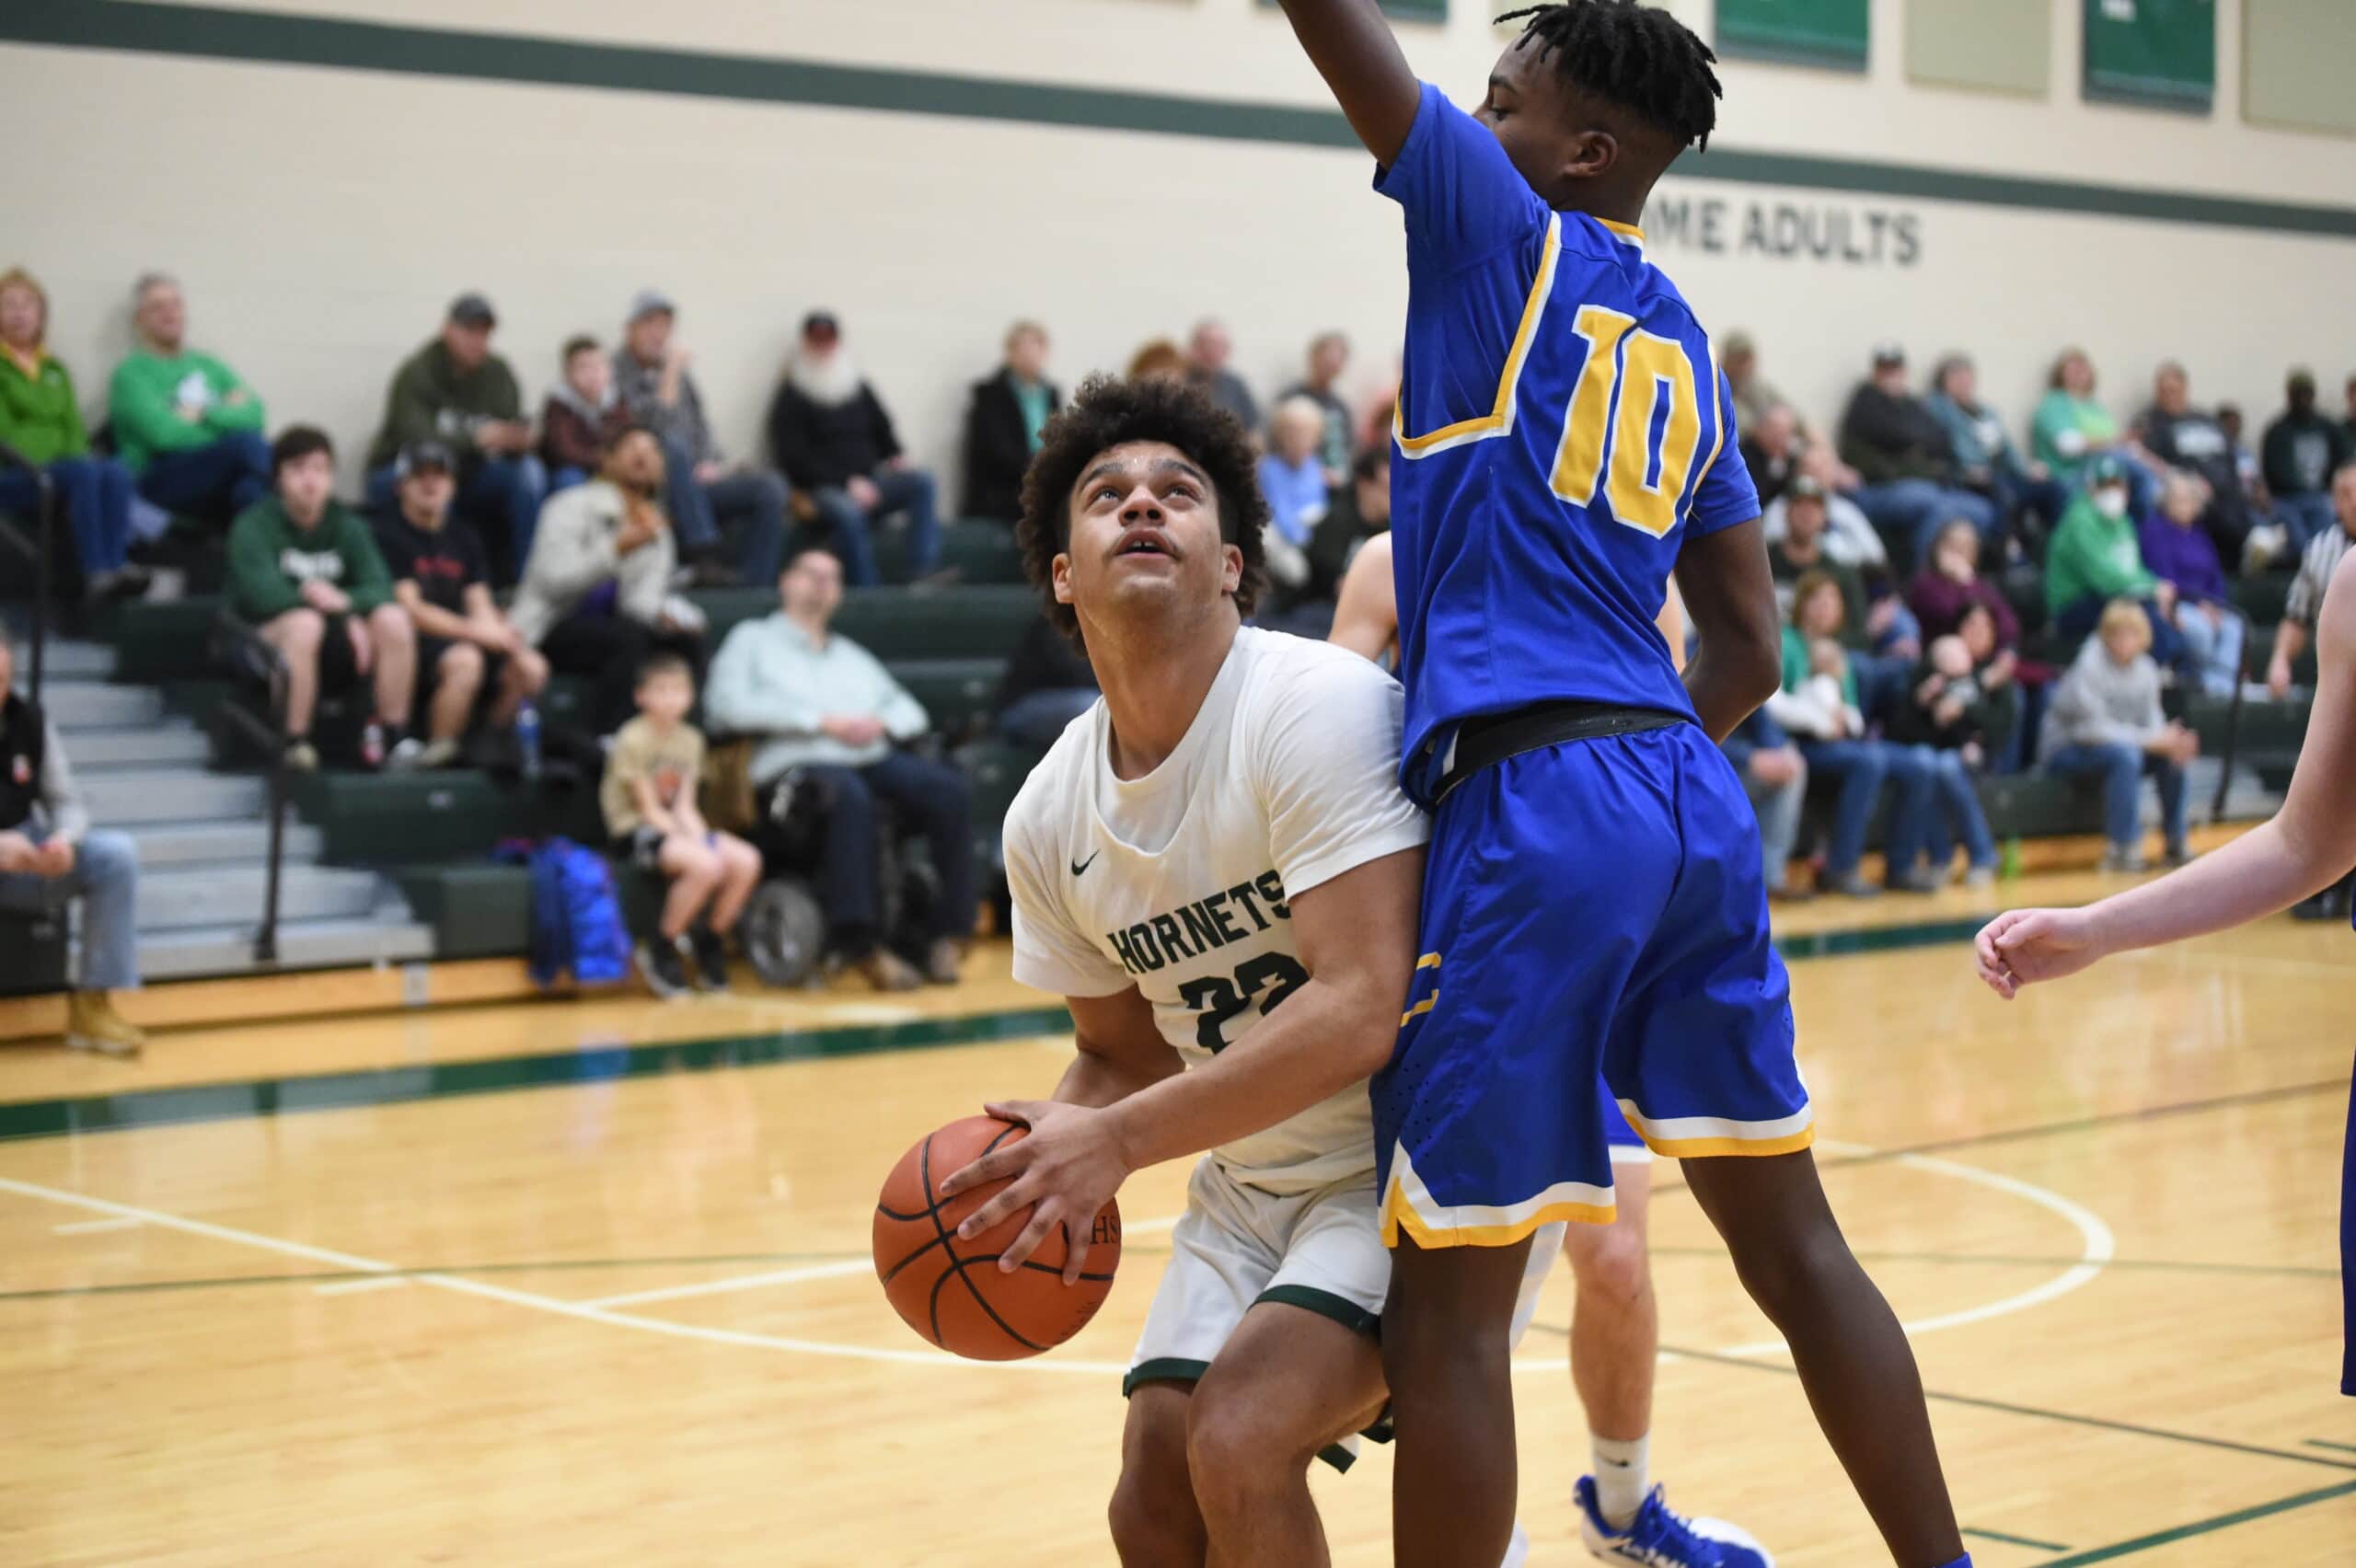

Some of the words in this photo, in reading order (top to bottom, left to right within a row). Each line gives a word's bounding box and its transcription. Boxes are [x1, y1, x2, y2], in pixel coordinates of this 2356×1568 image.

[1645, 193, 1728, 255] ME
[1739, 198, 1922, 267] ADULTS
[1548, 304, 1701, 540] 10
[1107, 869, 1292, 975] HORNETS
[1178, 951, 1311, 1055] 22
[1061, 1215, 1120, 1245] HS
